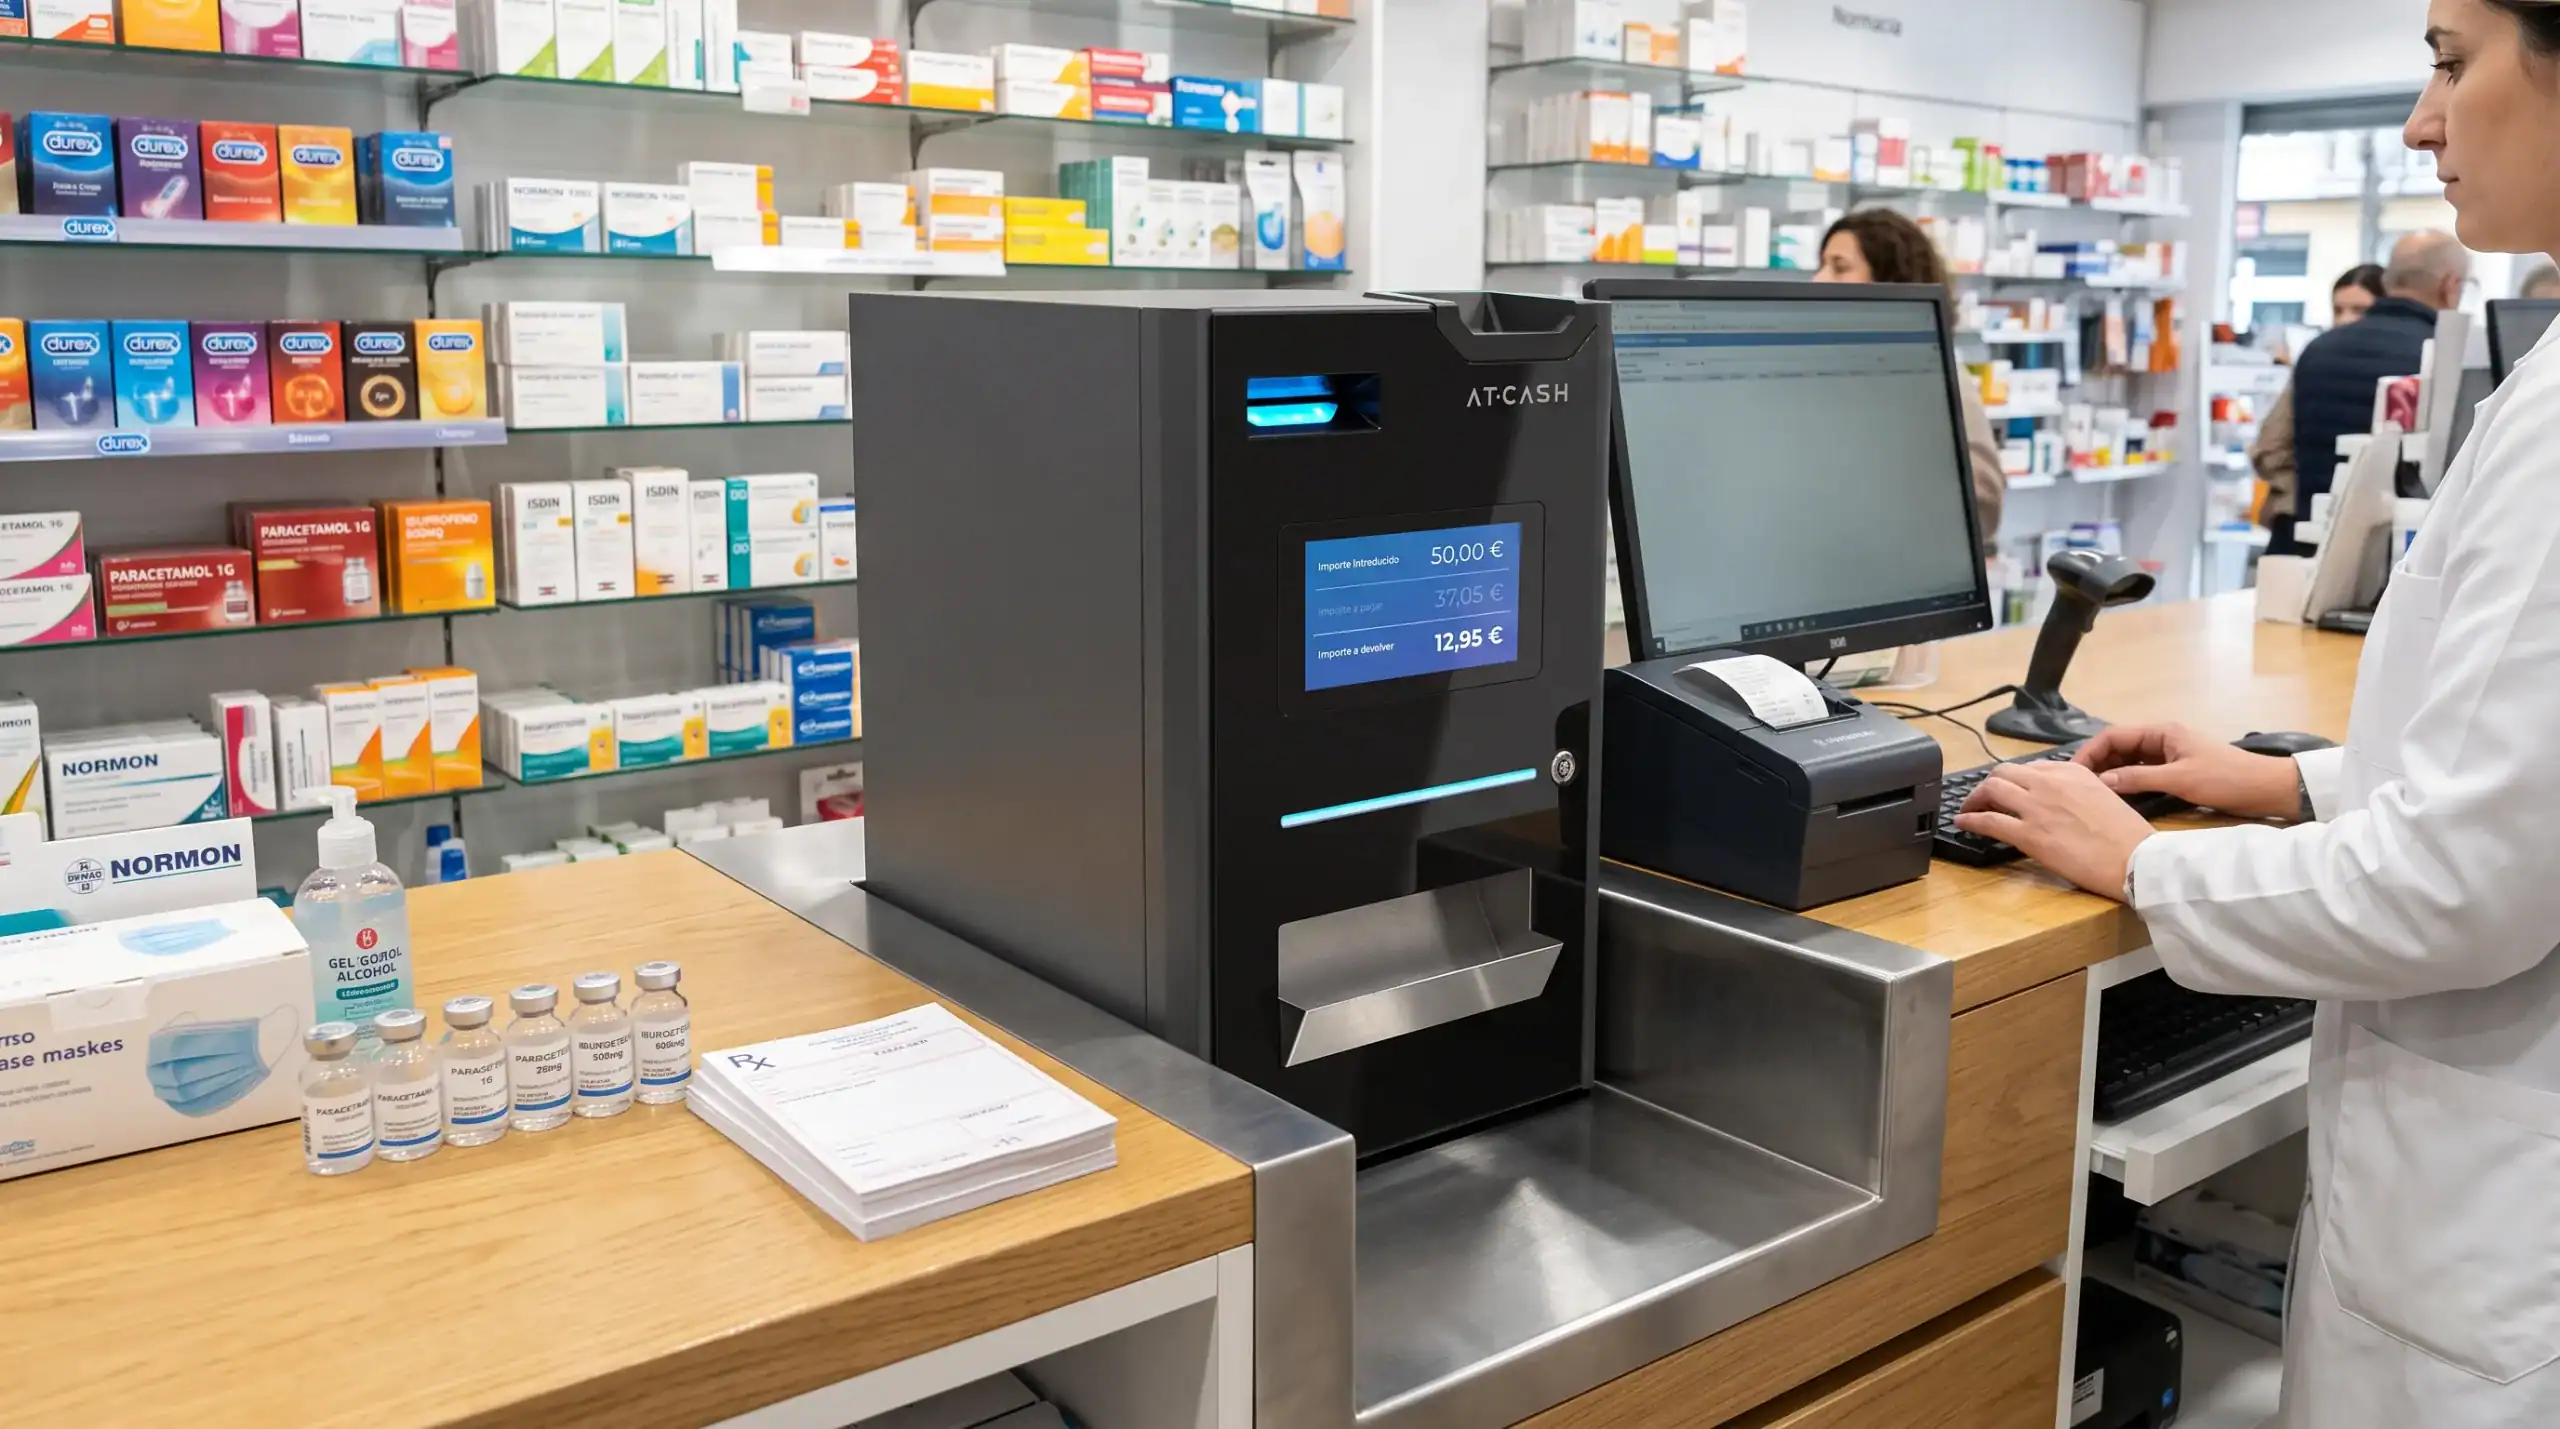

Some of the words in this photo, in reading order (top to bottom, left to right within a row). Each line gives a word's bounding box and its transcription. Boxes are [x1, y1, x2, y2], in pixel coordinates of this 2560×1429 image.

[49, 136, 96, 152] durex
[136, 138, 184, 156] durex
[217, 143, 260, 160] durex
[294, 147, 336, 165] durex
[398, 151, 438, 170] durex
[66, 219, 111, 235] durex
[47, 336, 93, 351] durex
[129, 336, 173, 351] durex
[207, 336, 252, 350] durex
[285, 336, 327, 350] durex
[359, 336, 399, 350] durex
[430, 335, 471, 350] durex
[101, 436, 145, 450] durex
[646, 485, 679, 498] ISDIN
[528, 497, 560, 509] ISDIN
[588, 494, 620, 506] ISDIN
[261, 522, 351, 538] PARACETAMOL
[355, 520, 371, 533] 1G
[1318, 562, 1352, 573] Importe
[1430, 542, 1484, 566] 50,00
[1489, 540, 1504, 559] €
[110, 566, 213, 583] PARACETAMOL
[217, 563, 235, 577] 1G
[1434, 585, 1484, 609] 37,05
[1490, 583, 1504, 602] €
[1318, 648, 1352, 661] Importe
[1353, 648, 1359, 656] a
[1360, 641, 1395, 655] devolver
[1434, 628, 1483, 653] 12,95
[1488, 625, 1504, 645] €
[62, 753, 159, 777] NORMON
[111, 843, 242, 879] NORMON
[328, 958, 355, 969] GEL
[337, 962, 397, 982] ALCOHOL
[43, 1039, 124, 1064] maskes
